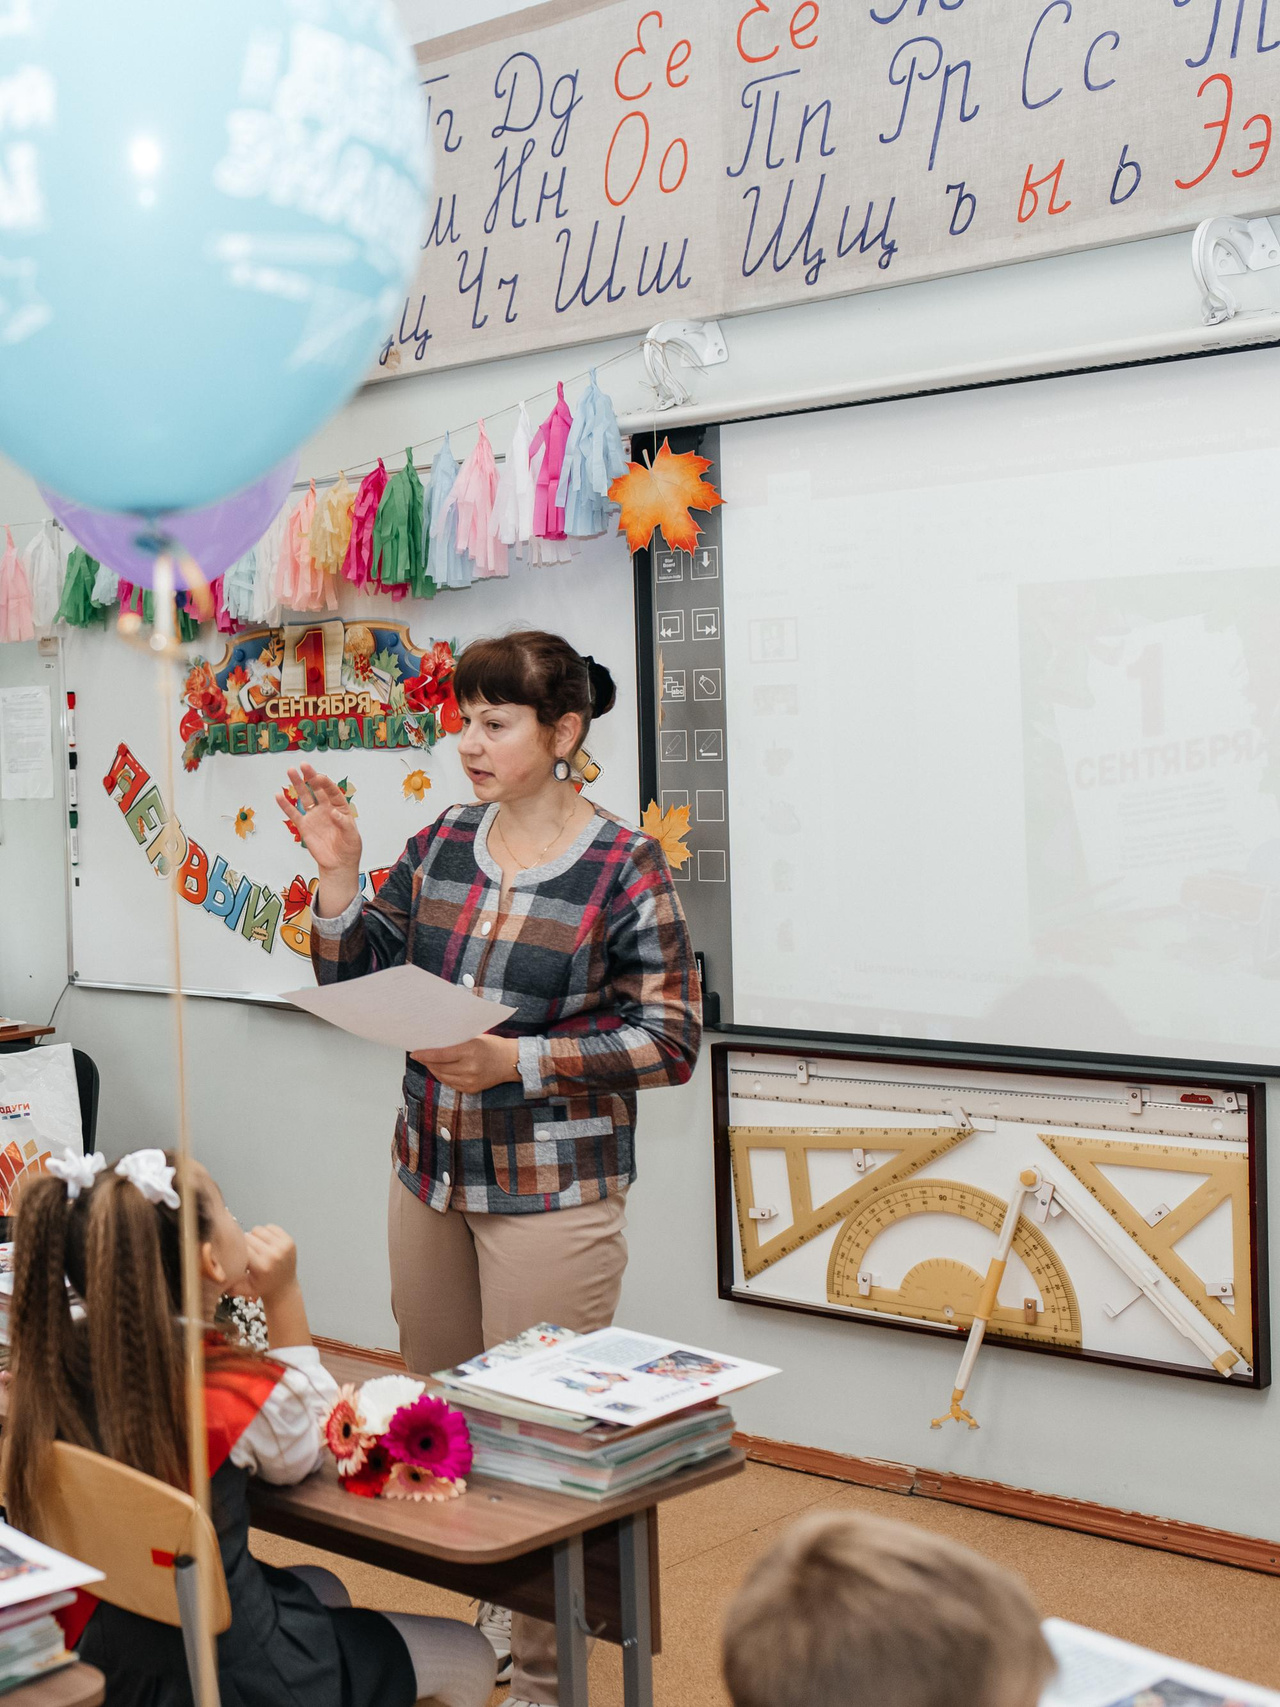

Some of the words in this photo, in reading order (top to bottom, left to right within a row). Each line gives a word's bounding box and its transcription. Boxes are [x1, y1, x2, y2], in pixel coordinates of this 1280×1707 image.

[613, 10, 692, 101] Ее
[1021, 0, 1120, 110] Сс
[605, 110, 688, 207] Оо
[1174, 72, 1272, 191] Ээ
[554, 214, 692, 313] Шш
[264, 692, 373, 720] СЕНТЯБРЯ
[295, 628, 327, 698] 1
[206, 721, 291, 756] ДЕНЬ
[297, 713, 439, 752] ЗНАНИЙ
[102, 741, 284, 954] ПЕРВЫЙ
